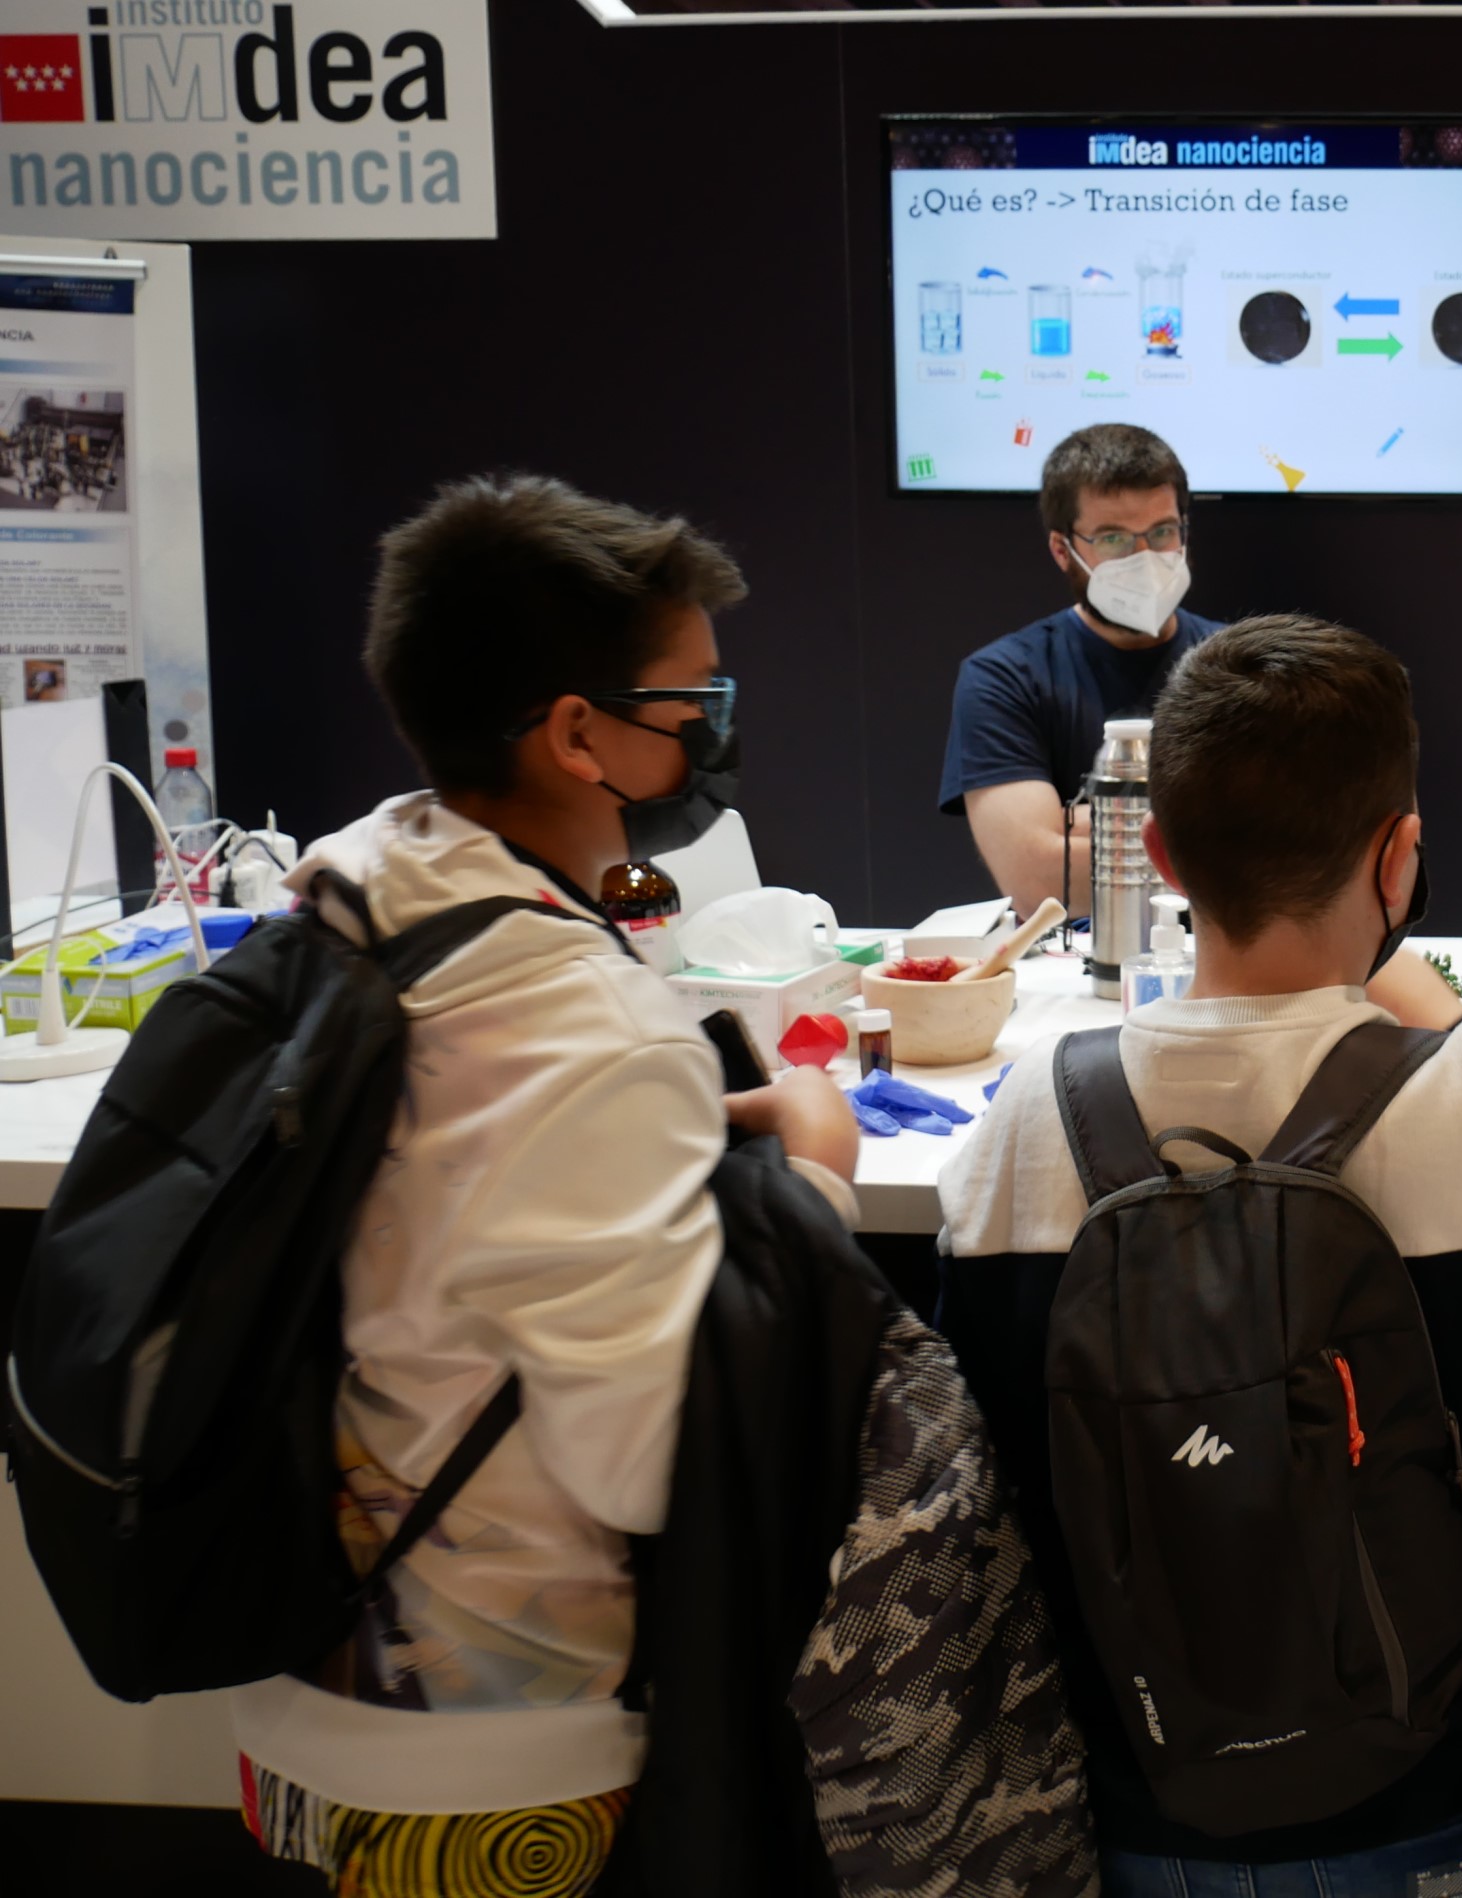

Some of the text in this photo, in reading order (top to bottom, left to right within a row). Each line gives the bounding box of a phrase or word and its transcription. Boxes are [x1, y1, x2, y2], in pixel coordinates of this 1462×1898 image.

[116, 0, 264, 26] instituto
[1177, 135, 1326, 165] nanociencia
[9, 131, 462, 207] nanociencia
[908, 189, 982, 218] ¿Qué
[992, 190, 1038, 212] es?
[1085, 188, 1236, 212] Transición
[1245, 189, 1280, 212] de
[1290, 189, 1349, 212] fase
[1140, 1692, 1165, 1745] ARPENAZ
